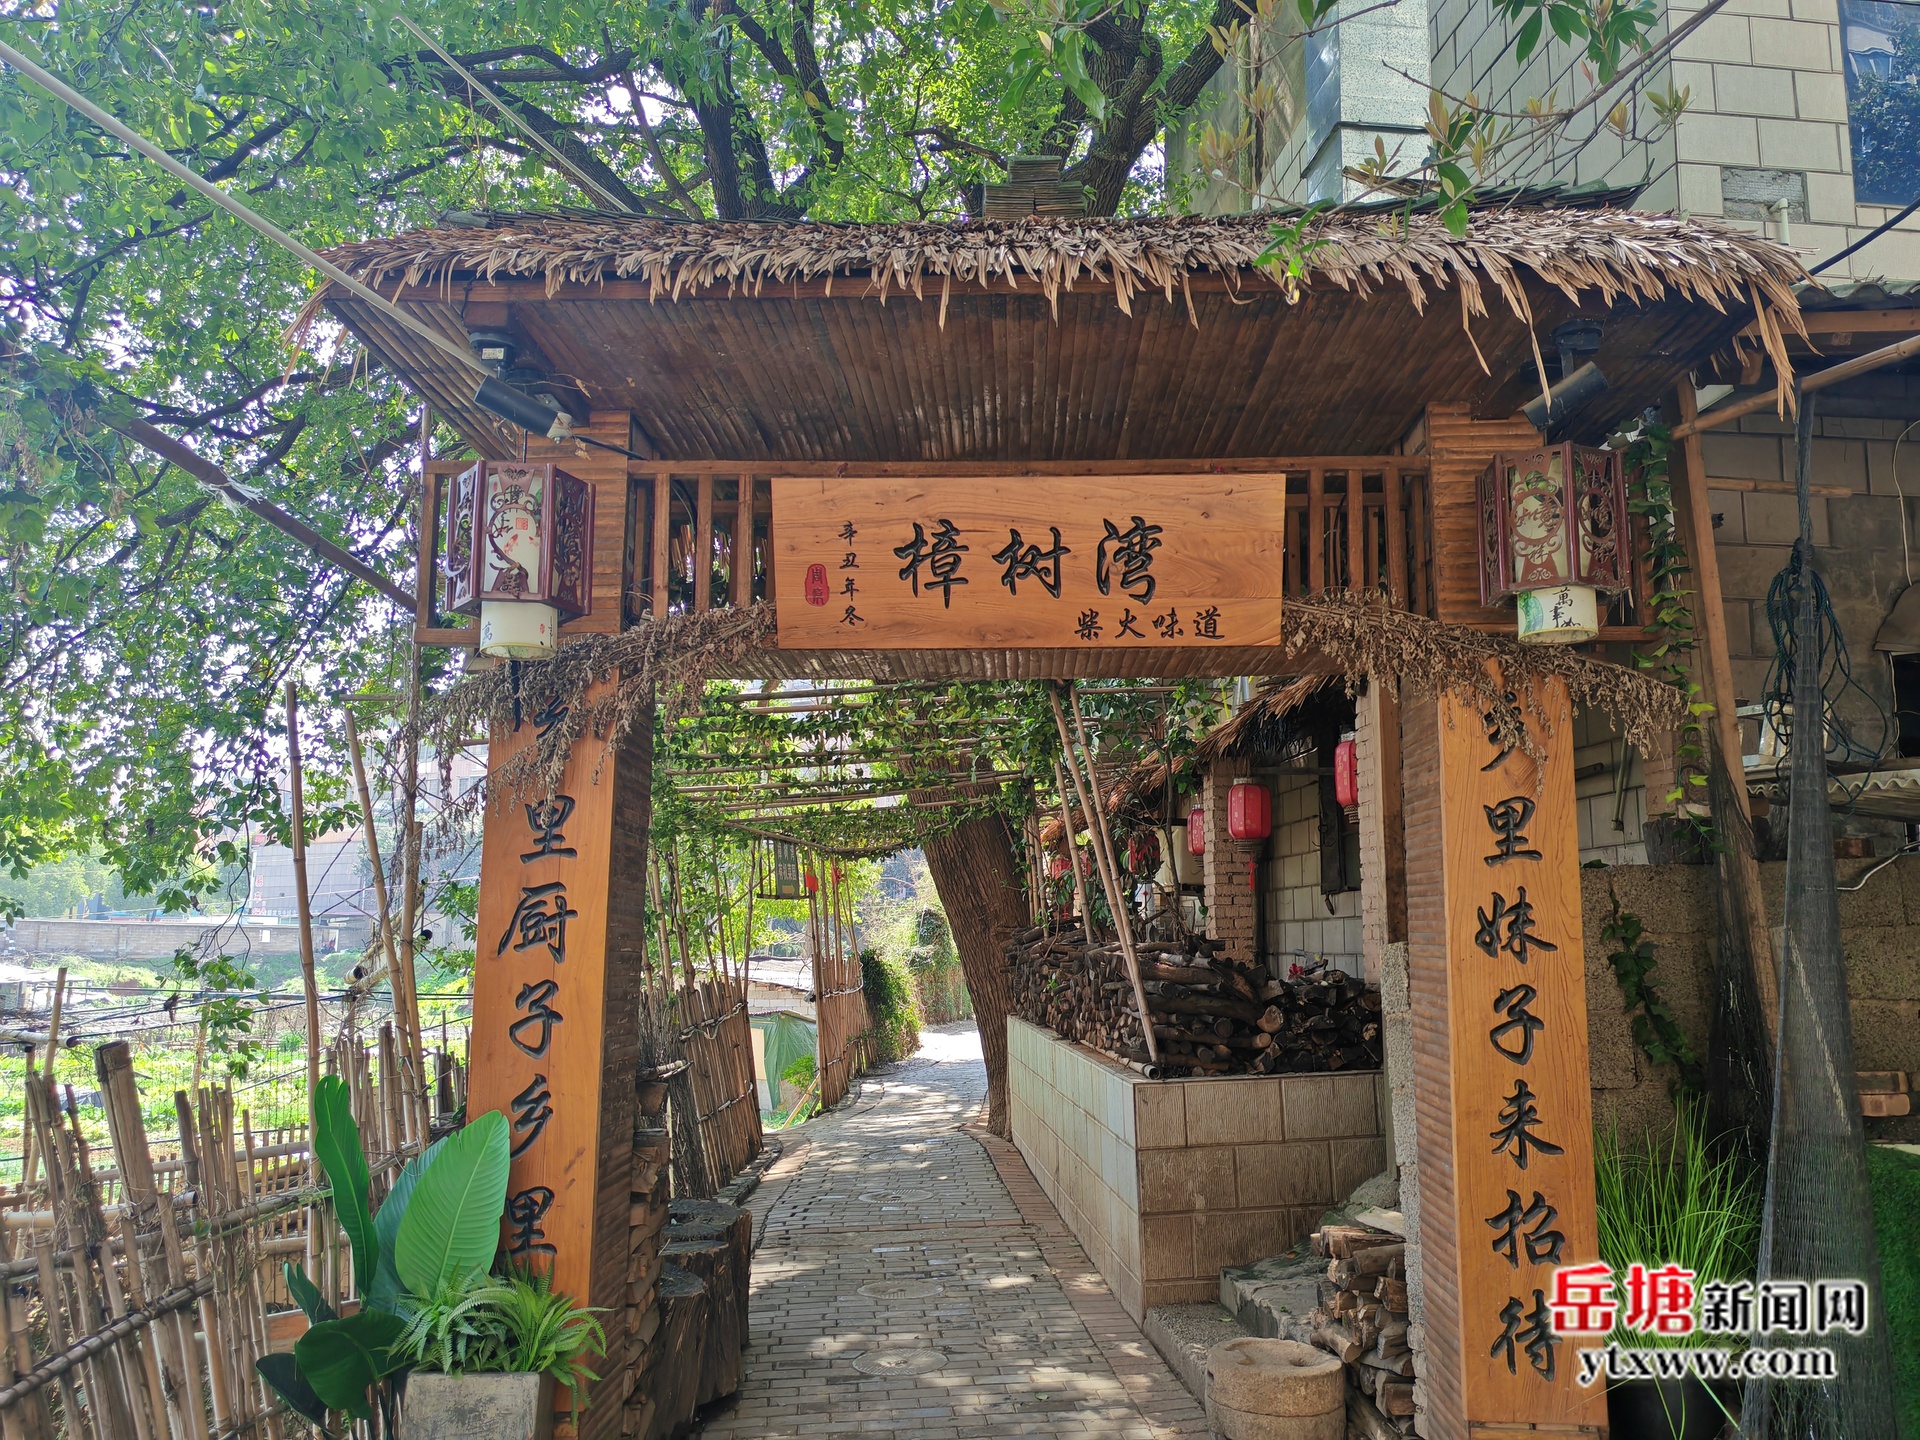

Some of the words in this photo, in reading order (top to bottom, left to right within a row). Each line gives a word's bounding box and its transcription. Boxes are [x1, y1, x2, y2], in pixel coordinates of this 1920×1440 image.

[838, 520, 864, 626] 辛丑年冬
[893, 515, 1163, 609] 樟树湾
[1073, 606, 1226, 641] 柴火味道
